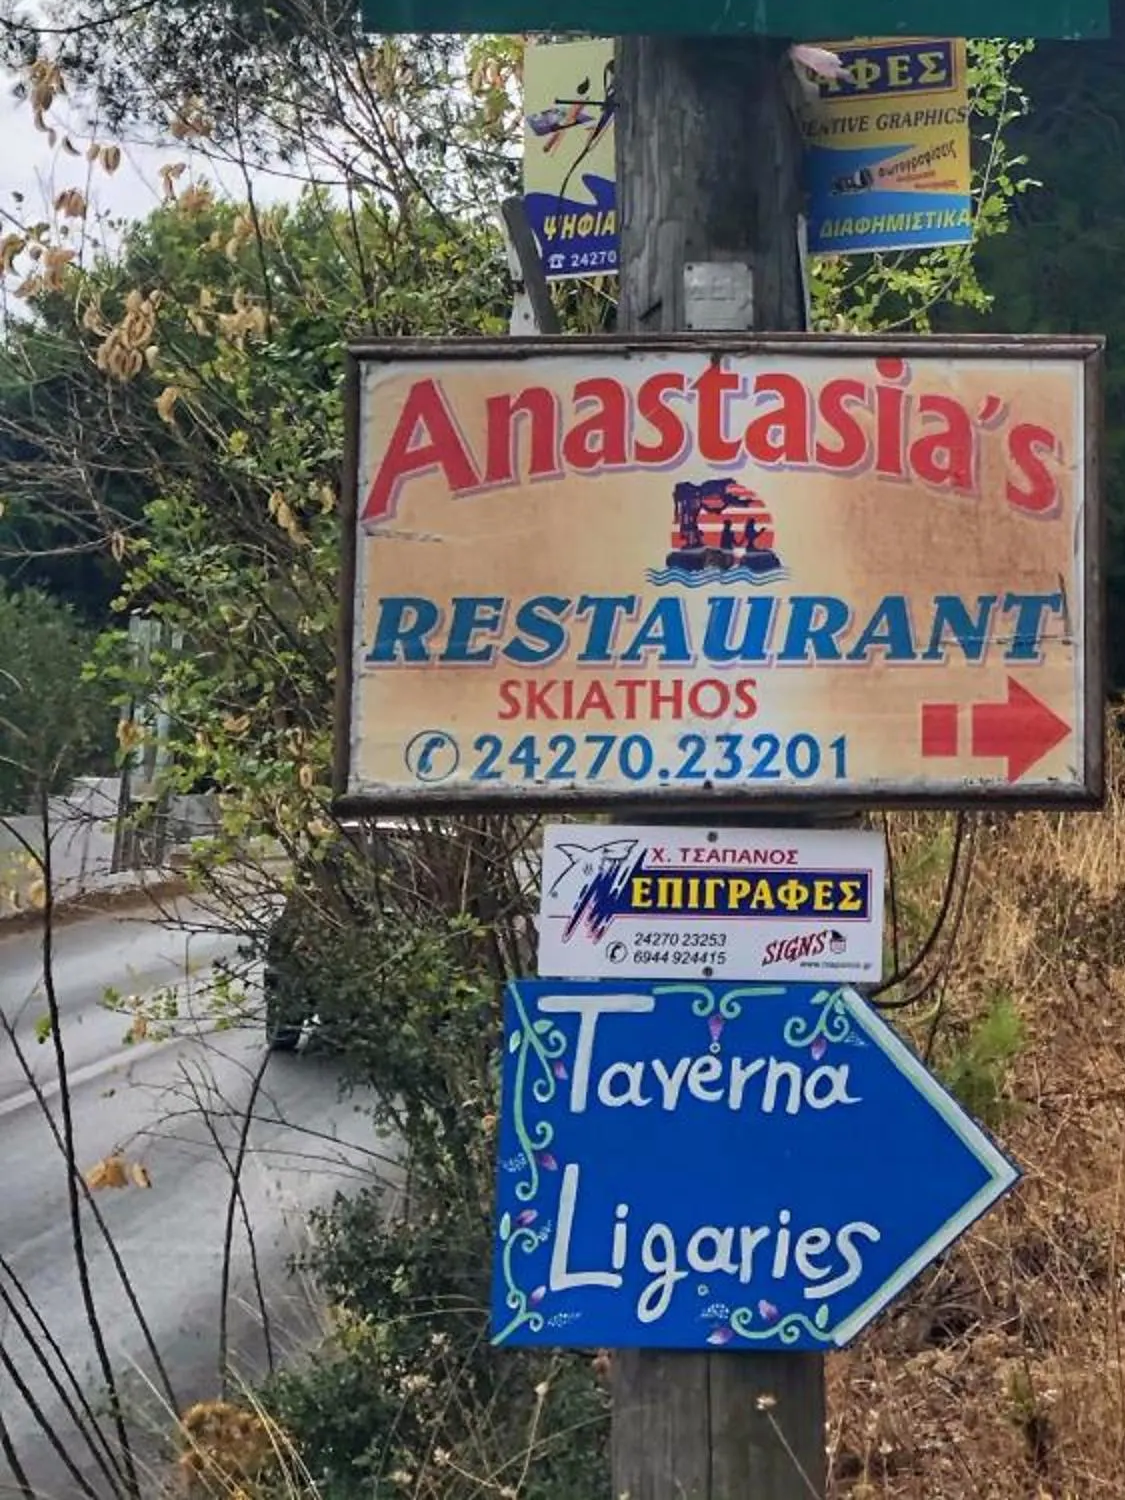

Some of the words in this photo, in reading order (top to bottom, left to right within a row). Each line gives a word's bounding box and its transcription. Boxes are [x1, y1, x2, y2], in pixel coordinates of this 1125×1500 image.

[875, 106, 967, 131] GRAPHICS
[360, 356, 1066, 521] Anastasia's
[365, 593, 1066, 668] RESTAURANT
[497, 678, 758, 721] SKIATHOS
[472, 733, 847, 781] 24270.23201
[680, 848, 799, 865] ΤΣΑΠΑΝΟΣ
[630, 876, 861, 911] ΕΠΙΓΡΑΦΕΣ
[634, 931, 680, 946] 24270
[680, 932, 727, 947] 23253
[761, 929, 828, 967] SIGNS
[537, 994, 863, 1114] Taverna
[549, 1162, 881, 1323] Ligaries
